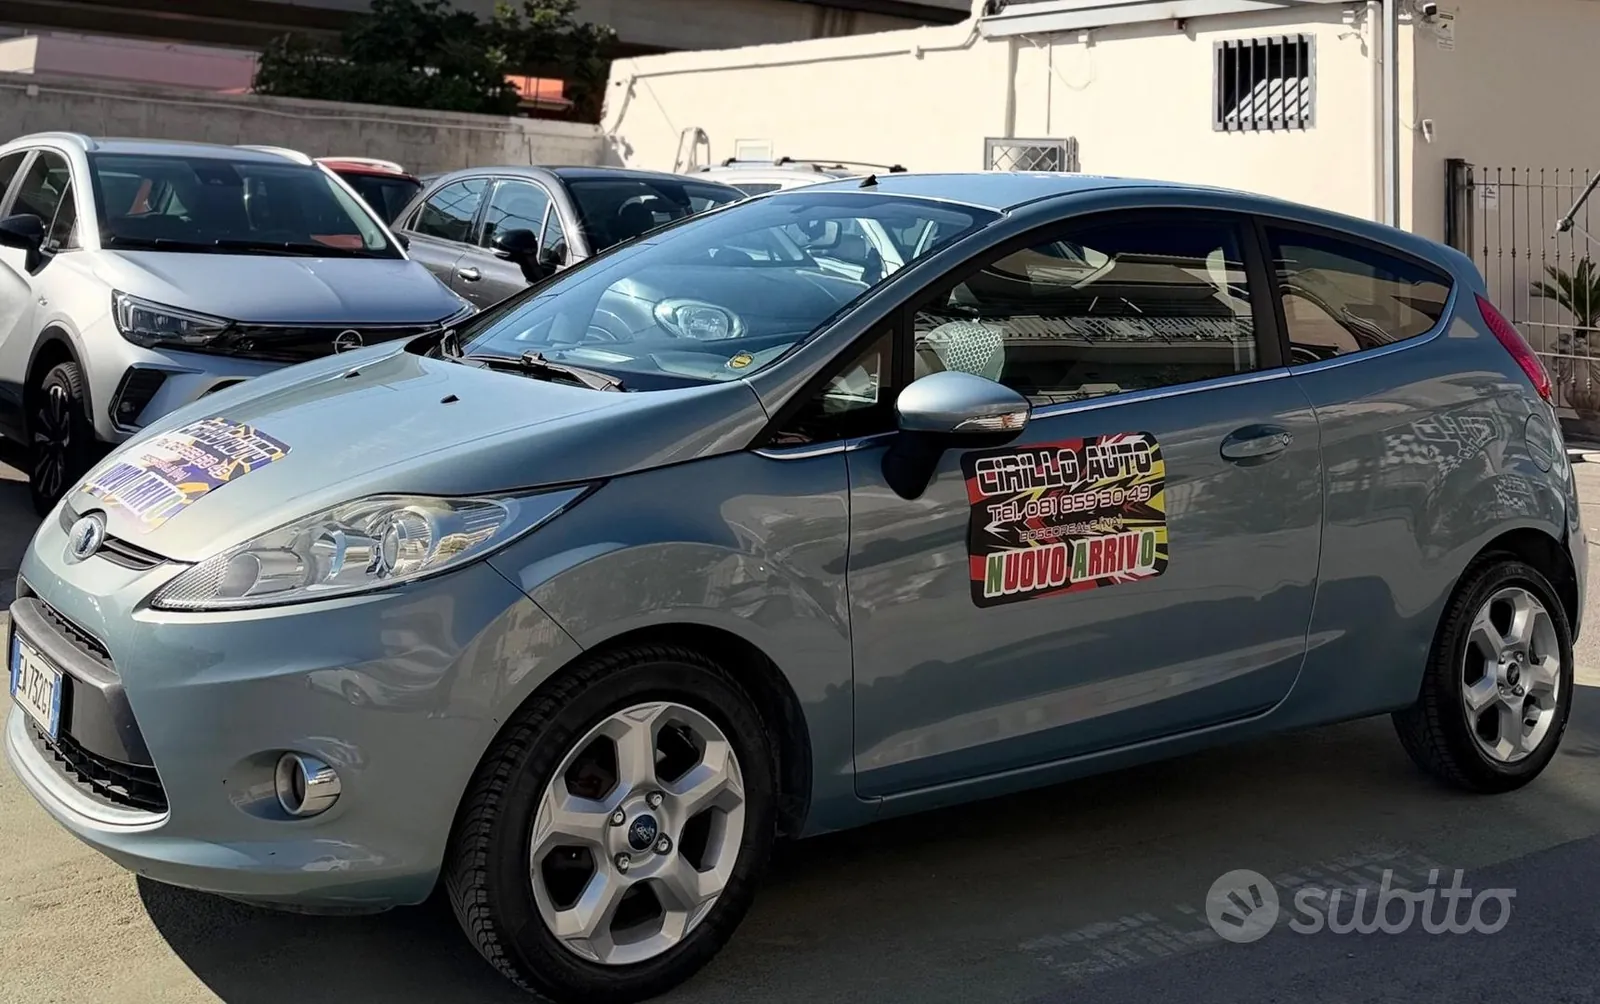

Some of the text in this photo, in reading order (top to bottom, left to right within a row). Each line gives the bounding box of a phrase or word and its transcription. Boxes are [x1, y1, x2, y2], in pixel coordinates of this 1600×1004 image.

[1086, 439, 1152, 481] AUTO
[987, 484, 1151, 525] Tel. 081 859 30 49
[1019, 522, 1098, 542] BOSCOREALE
[985, 531, 1156, 597] NUOVO ARRIVO
